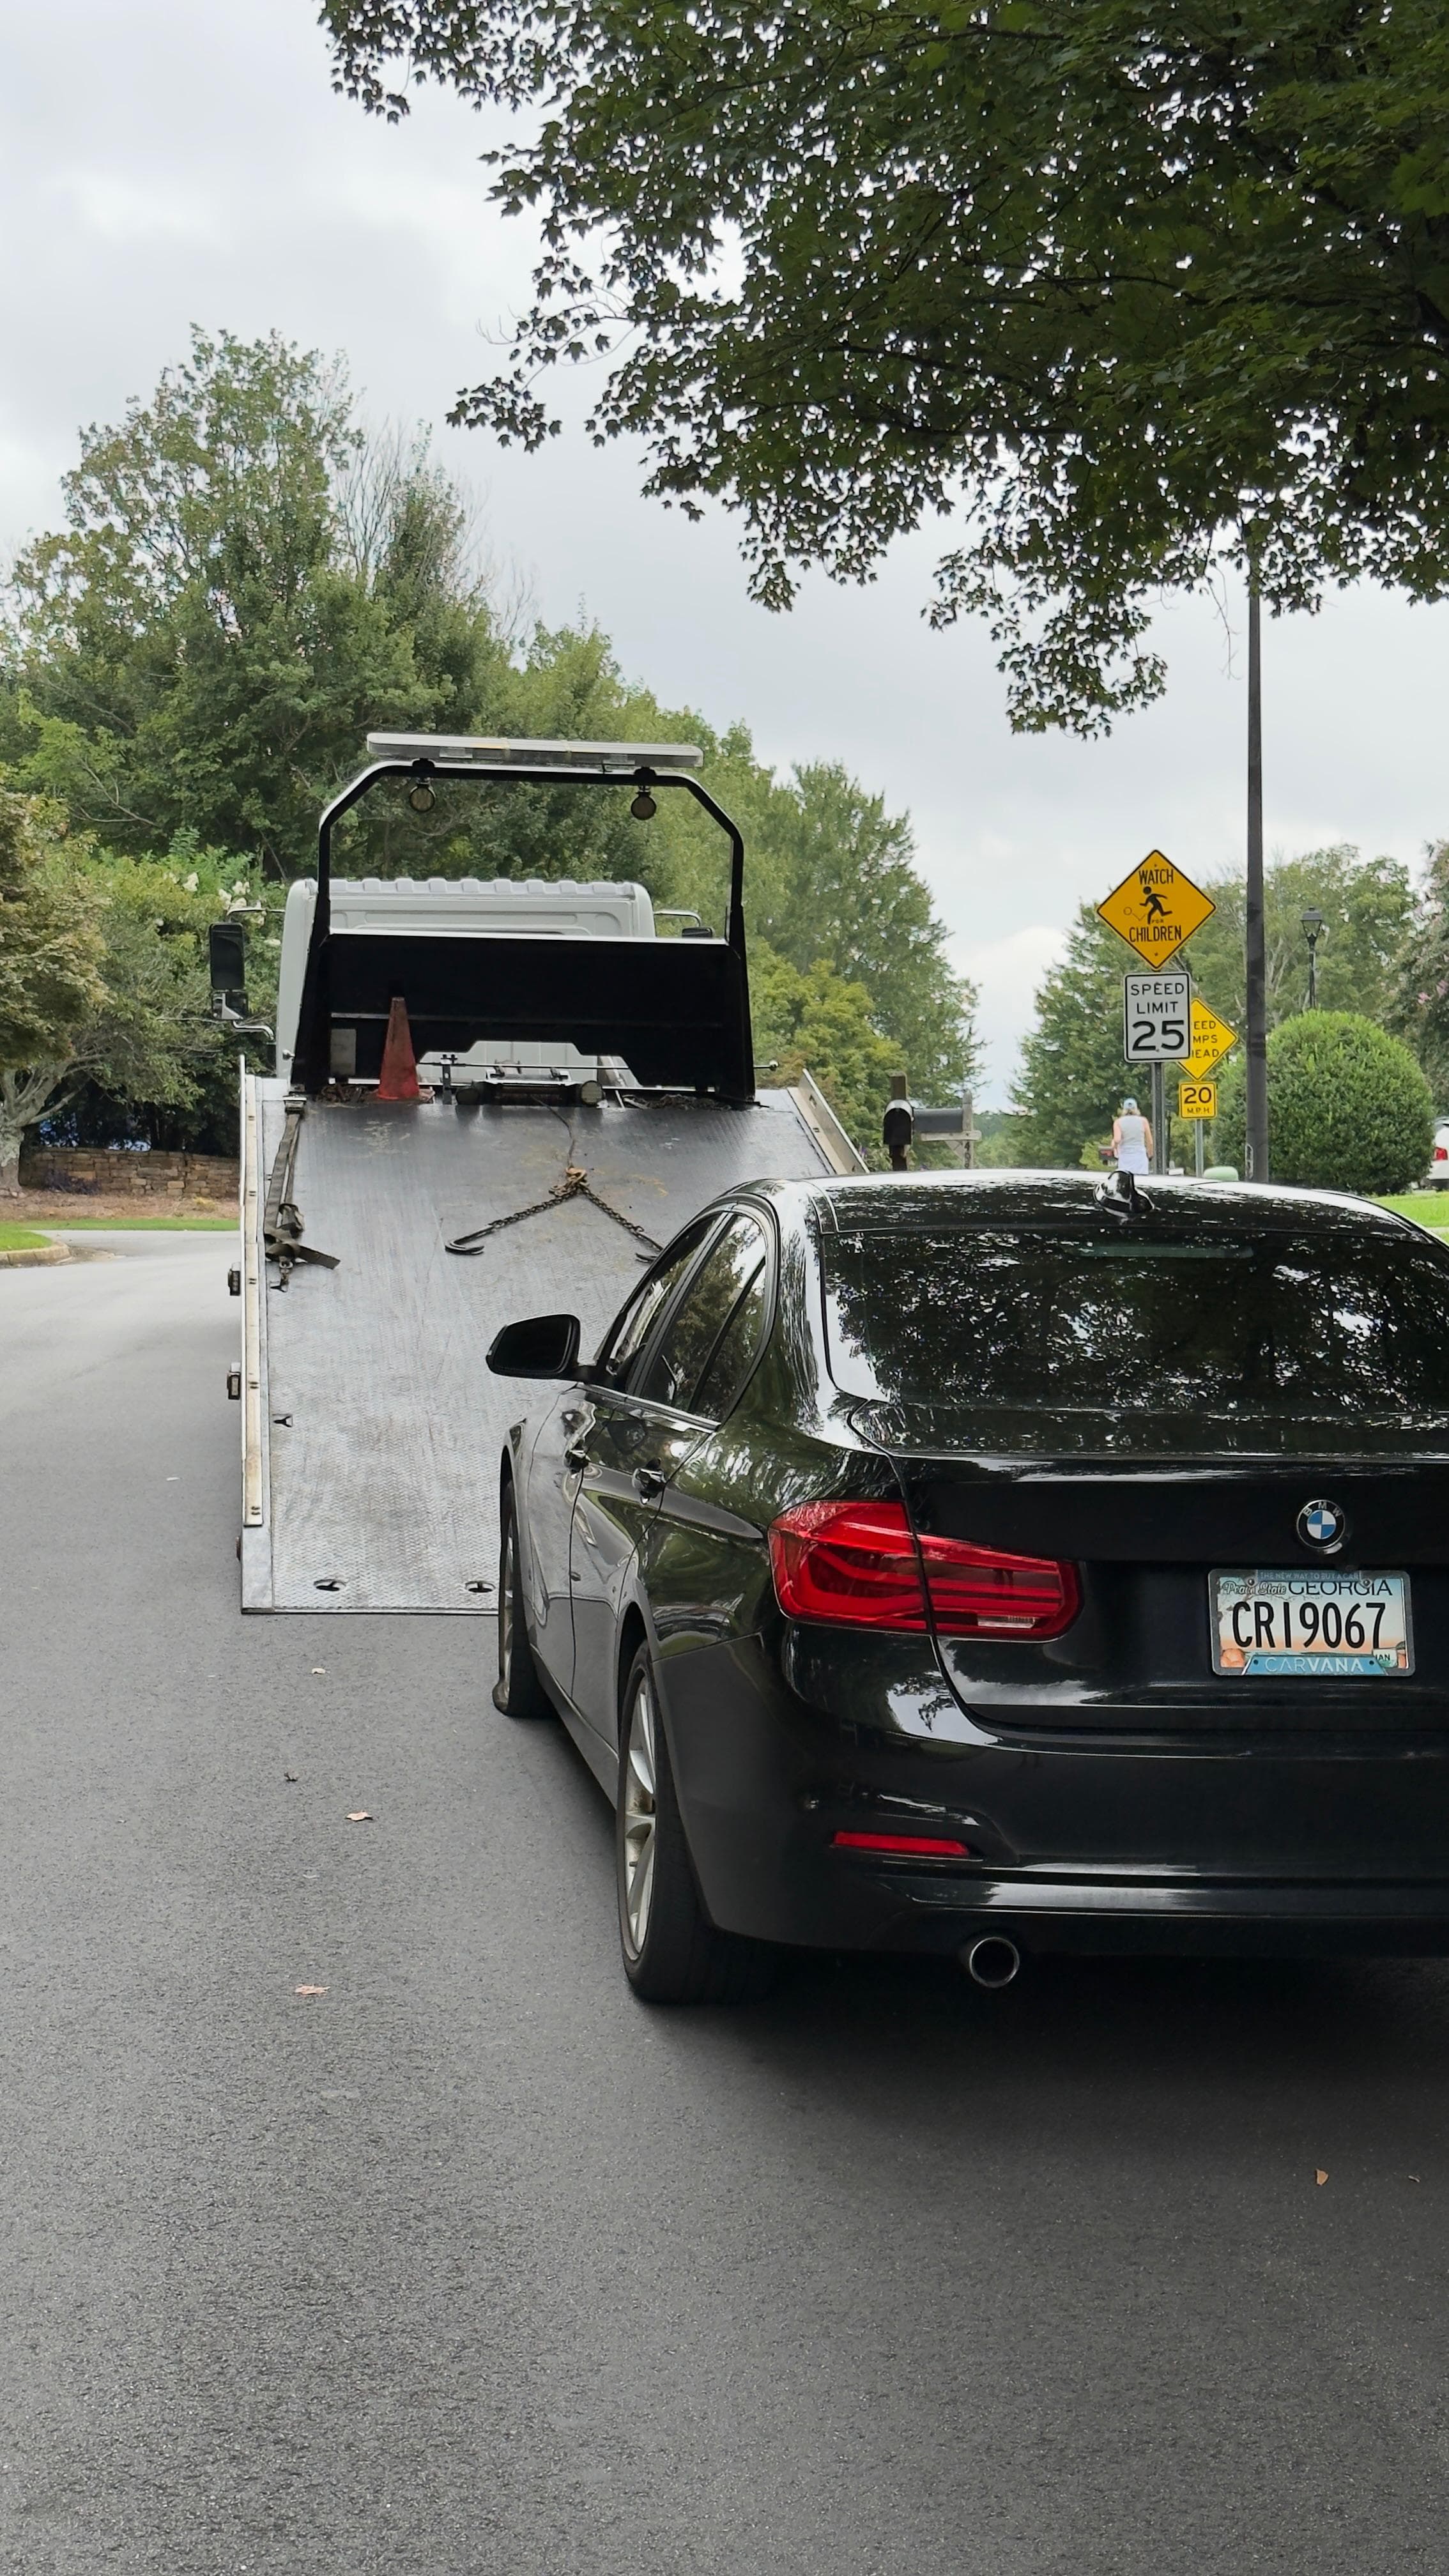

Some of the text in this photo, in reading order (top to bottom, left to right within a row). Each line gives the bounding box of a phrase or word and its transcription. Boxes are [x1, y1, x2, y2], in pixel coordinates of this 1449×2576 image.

[1138, 868, 1174, 885] WATCH
[1129, 925, 1182, 942] CHILDREN
[1131, 983, 1184, 996] SPEED
[1137, 1001, 1179, 1014] LIMIT
[1193, 1020, 1216, 1030] EED
[1132, 1020, 1184, 1052] 25
[1193, 1034, 1218, 1043] MPS
[1192, 1048, 1220, 1059] EAD
[1183, 1087, 1212, 1104] 20
[1302, 1501, 1343, 1517] BMW
[1260, 1572, 1274, 1580] THE
[1275, 1572, 1292, 1580] NEW
[1293, 1572, 1308, 1580] WAY
[1310, 1572, 1320, 1580] TO
[1257, 1581, 1287, 1595] State
[1288, 1580, 1393, 1596] GEORGIA
[1232, 1601, 1386, 1649] CRI9067
[1264, 1657, 1365, 1674] CARVANA
